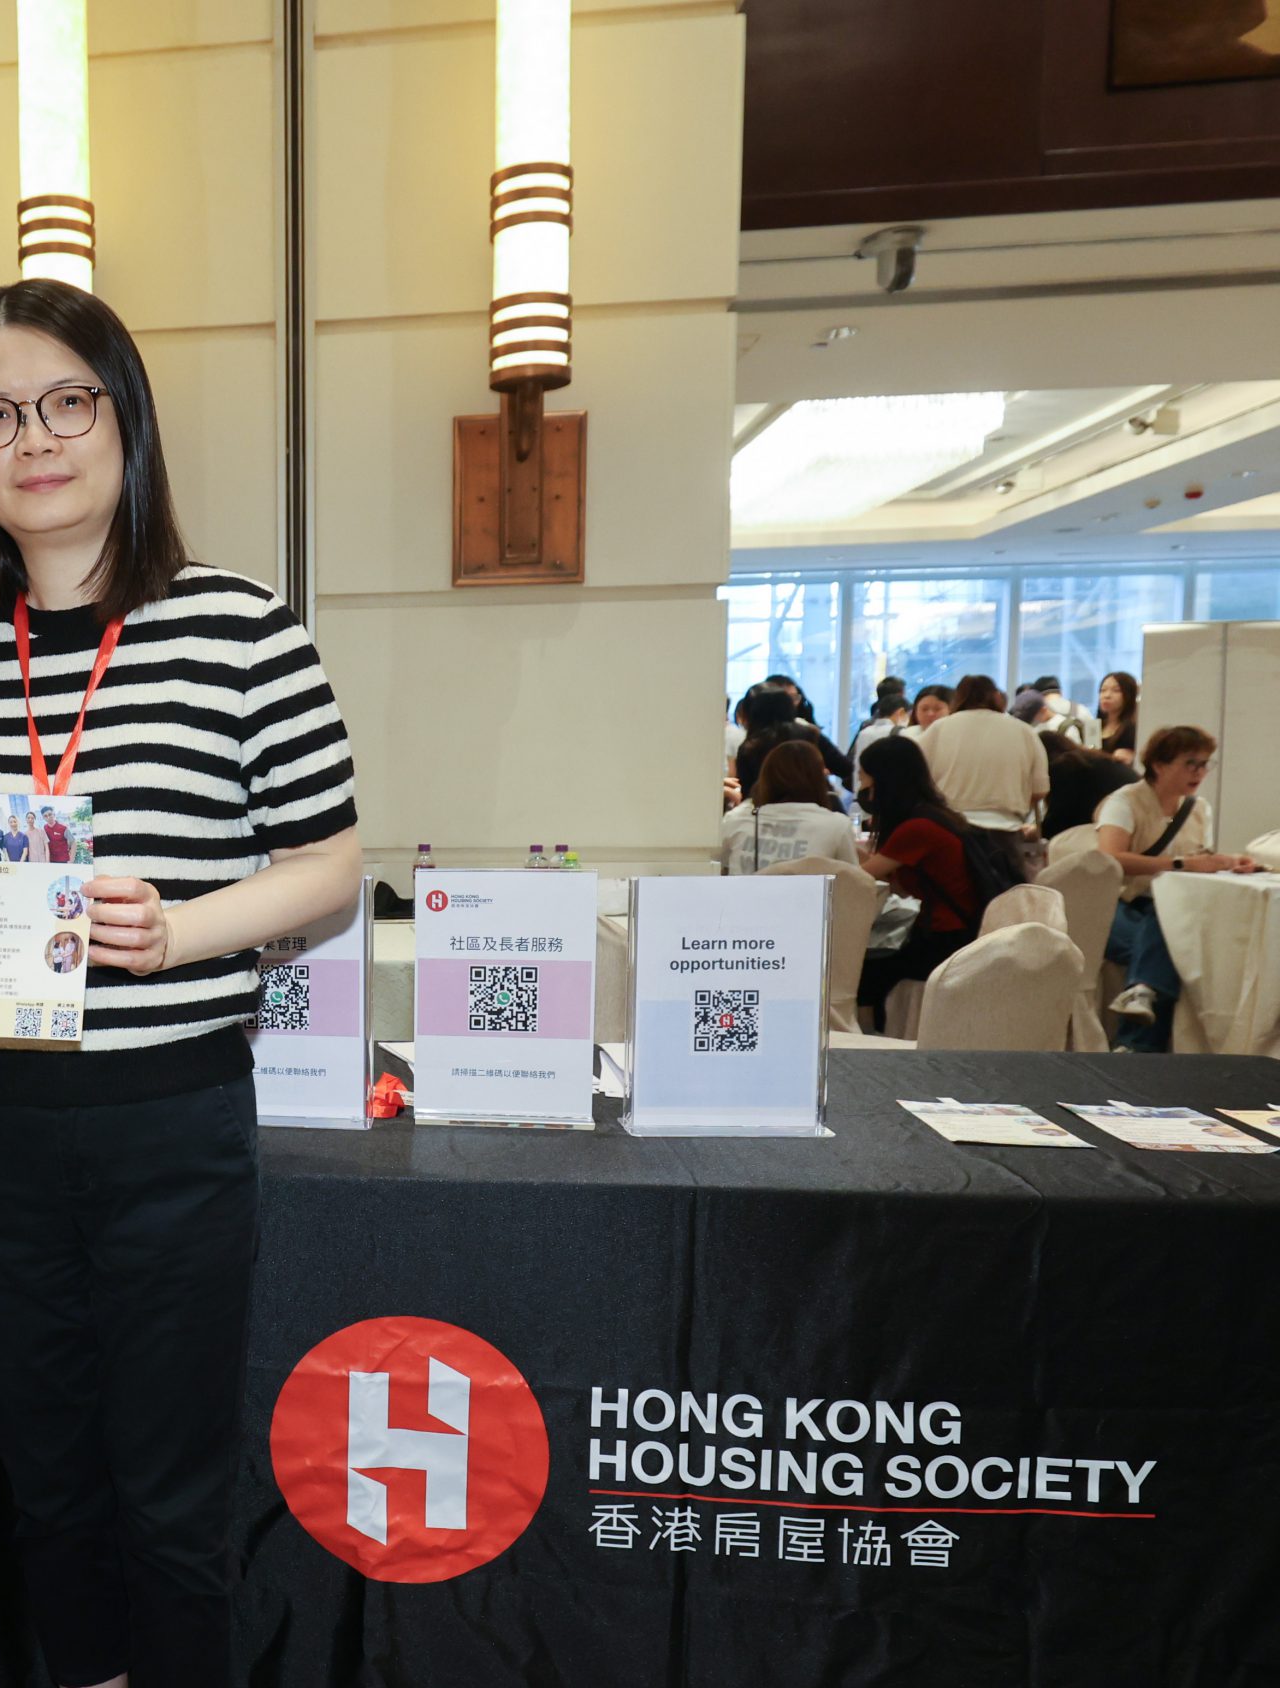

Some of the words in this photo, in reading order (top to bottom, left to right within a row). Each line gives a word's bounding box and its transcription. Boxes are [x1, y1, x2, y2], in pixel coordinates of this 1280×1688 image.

[450, 936, 563, 953] 社區及長者服務
[682, 937, 728, 950] Learn
[732, 939, 775, 950] more
[670, 957, 786, 973] opportunities!
[451, 1067, 556, 1080] 請掃描二維碼以便聯絡我們
[590, 1386, 763, 1438] HONG
[785, 1397, 961, 1446] KONG
[589, 1438, 864, 1496] HOUSING
[884, 1454, 1157, 1503] SOCIETY
[588, 1503, 960, 1568] 香港房屋協會
